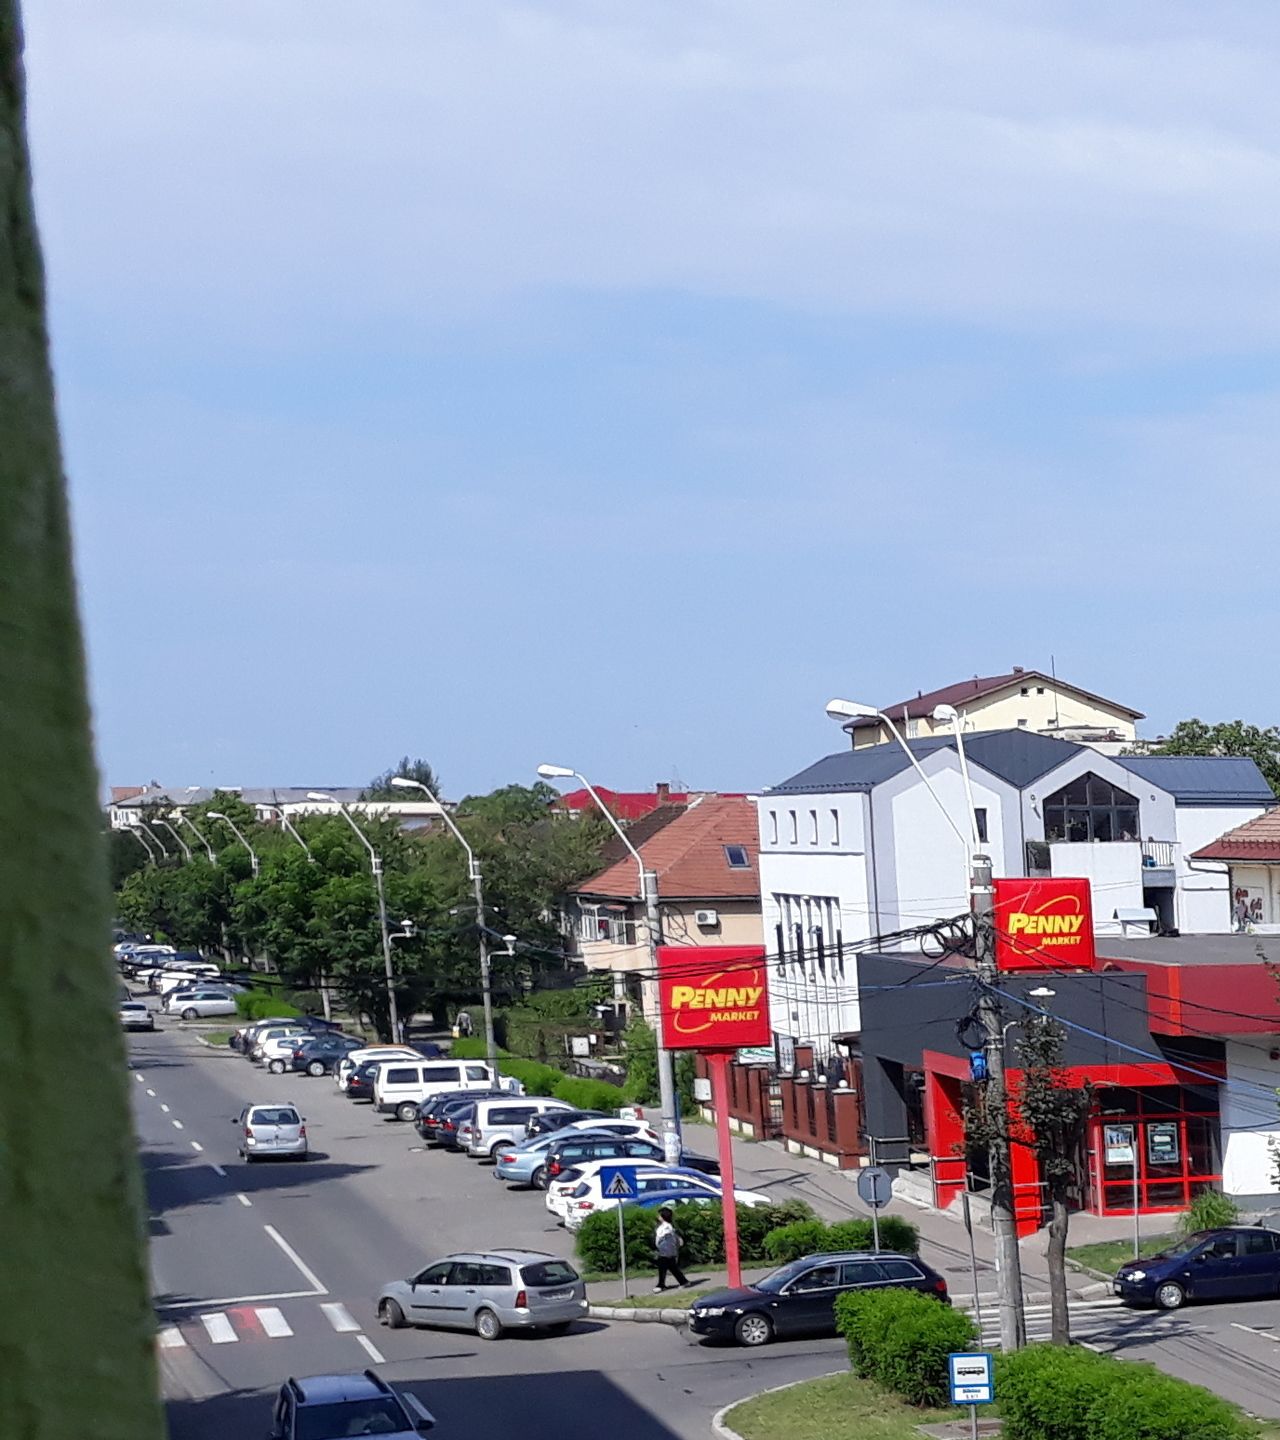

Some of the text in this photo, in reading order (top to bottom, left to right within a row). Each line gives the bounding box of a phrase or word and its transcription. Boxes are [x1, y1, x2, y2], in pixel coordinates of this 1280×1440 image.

[1008, 912, 1084, 934] PENNY
[1041, 936, 1081, 945] MARKET
[671, 986, 763, 1010] PENNY
[709, 1011, 760, 1022] MARKET
